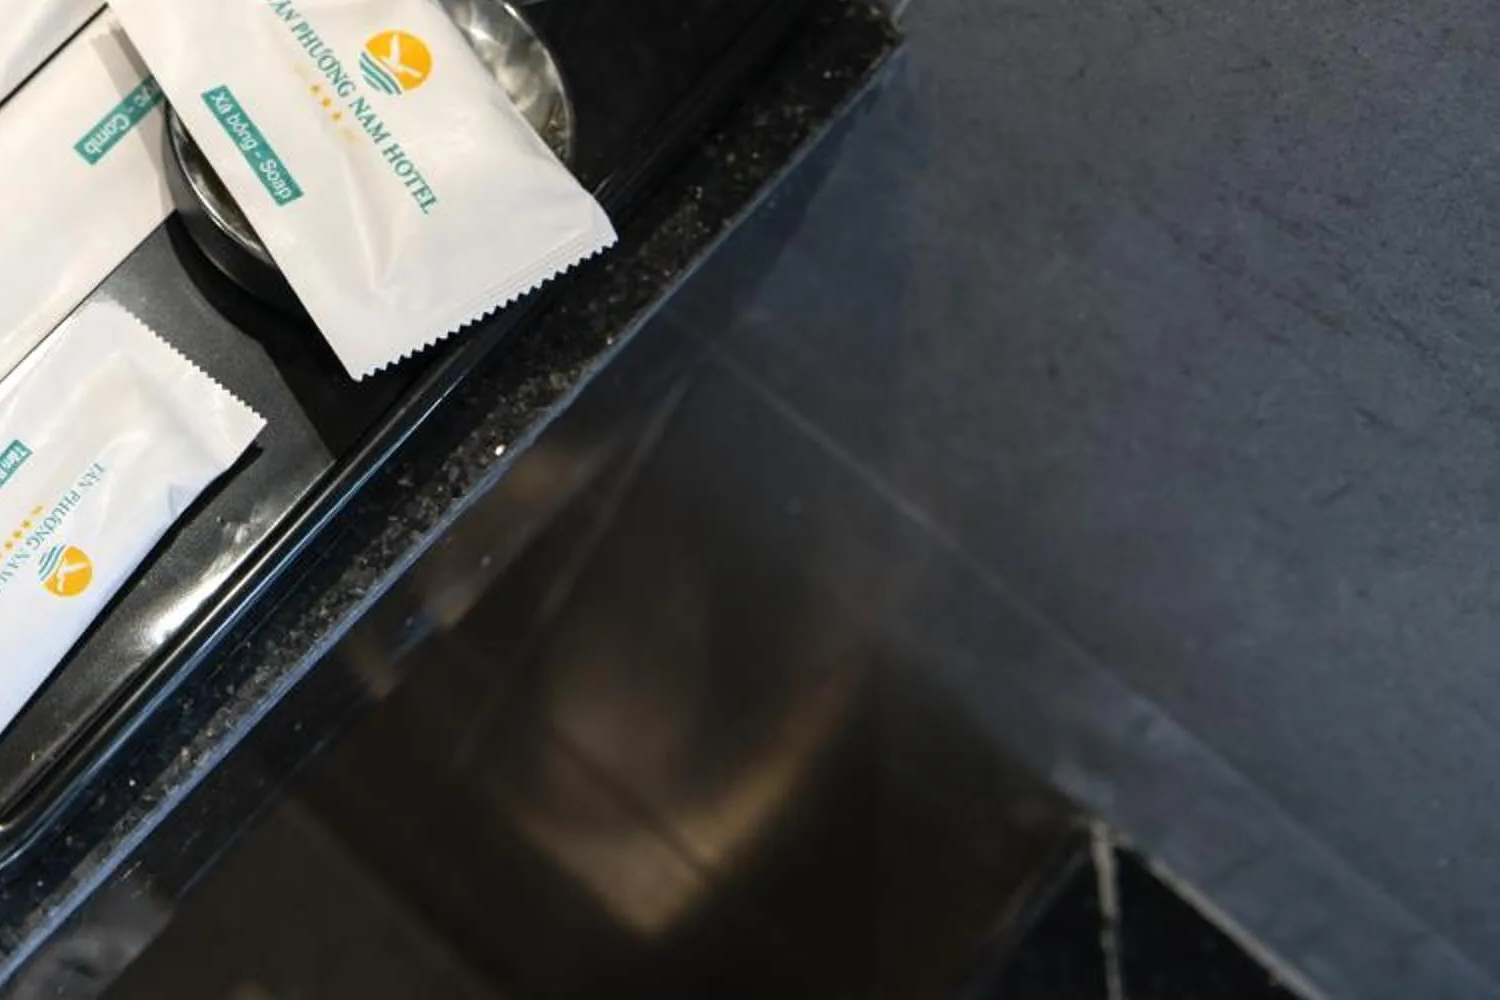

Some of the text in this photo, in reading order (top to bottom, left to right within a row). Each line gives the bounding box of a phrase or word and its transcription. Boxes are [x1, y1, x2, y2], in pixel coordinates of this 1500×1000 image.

[82, 112, 132, 157] Comb
[347, 96, 389, 144] NAM
[380, 142, 441, 214] HOTEL
[255, 155, 297, 201] Soap
